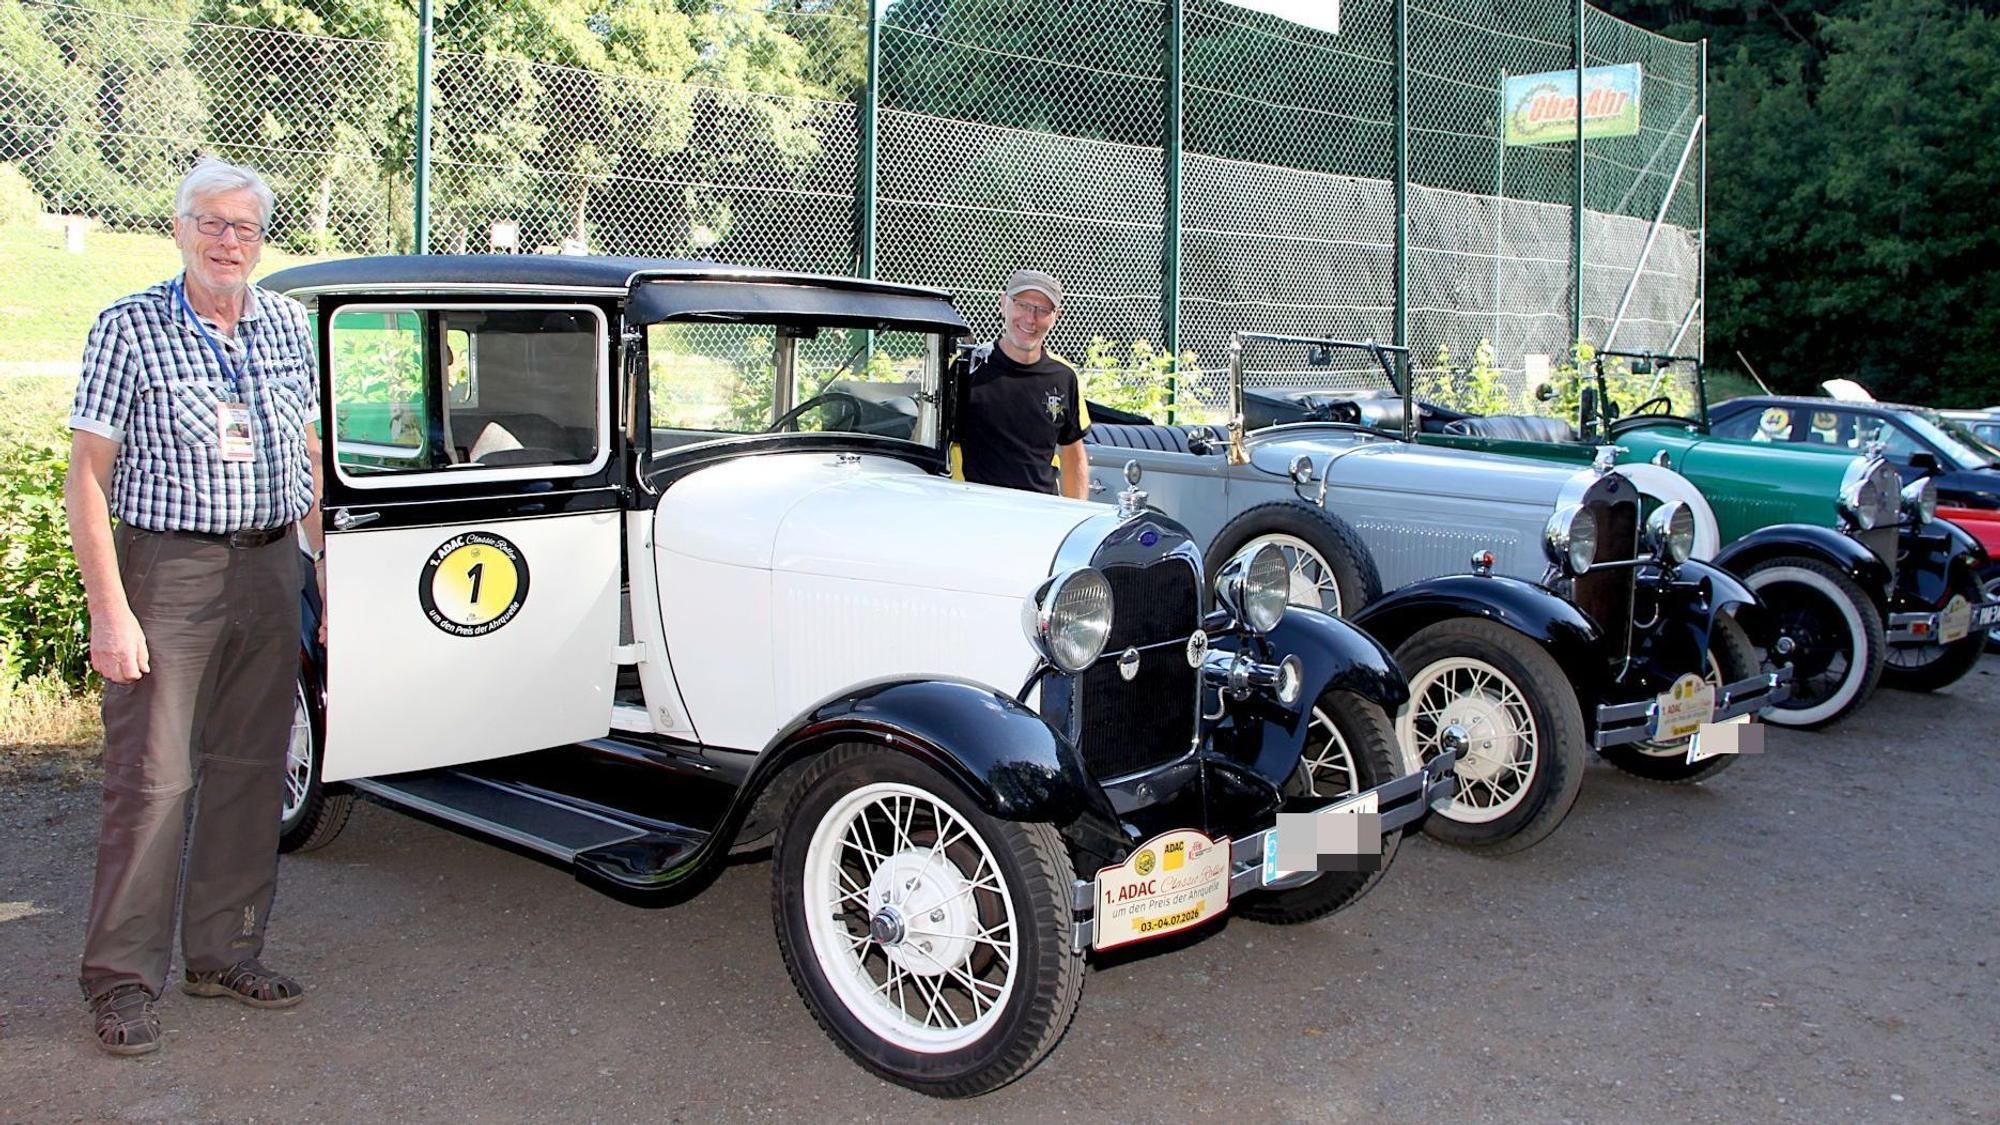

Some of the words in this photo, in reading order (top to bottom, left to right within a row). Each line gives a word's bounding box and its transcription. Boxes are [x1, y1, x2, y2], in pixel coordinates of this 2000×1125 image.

[437, 536, 465, 559] ADAC
[466, 533, 496, 545] Classic
[467, 563, 483, 604] 1
[429, 609, 442, 623] um
[440, 620, 456, 632] den
[455, 626, 474, 635] Preis
[474, 625, 488, 634] der
[488, 601, 520, 631] Ahrquelle
[1164, 841, 1184, 854] ADAC
[1105, 890, 1115, 905] 1.
[1119, 880, 1156, 902] ADAC
[1112, 909, 1126, 919] um
[1129, 903, 1146, 915] den
[1149, 899, 1170, 910] Preis
[1173, 893, 1187, 904] der
[1189, 881, 1219, 899] Ahrquelle
[1141, 909, 1199, 932] 03.-04.07.2026
